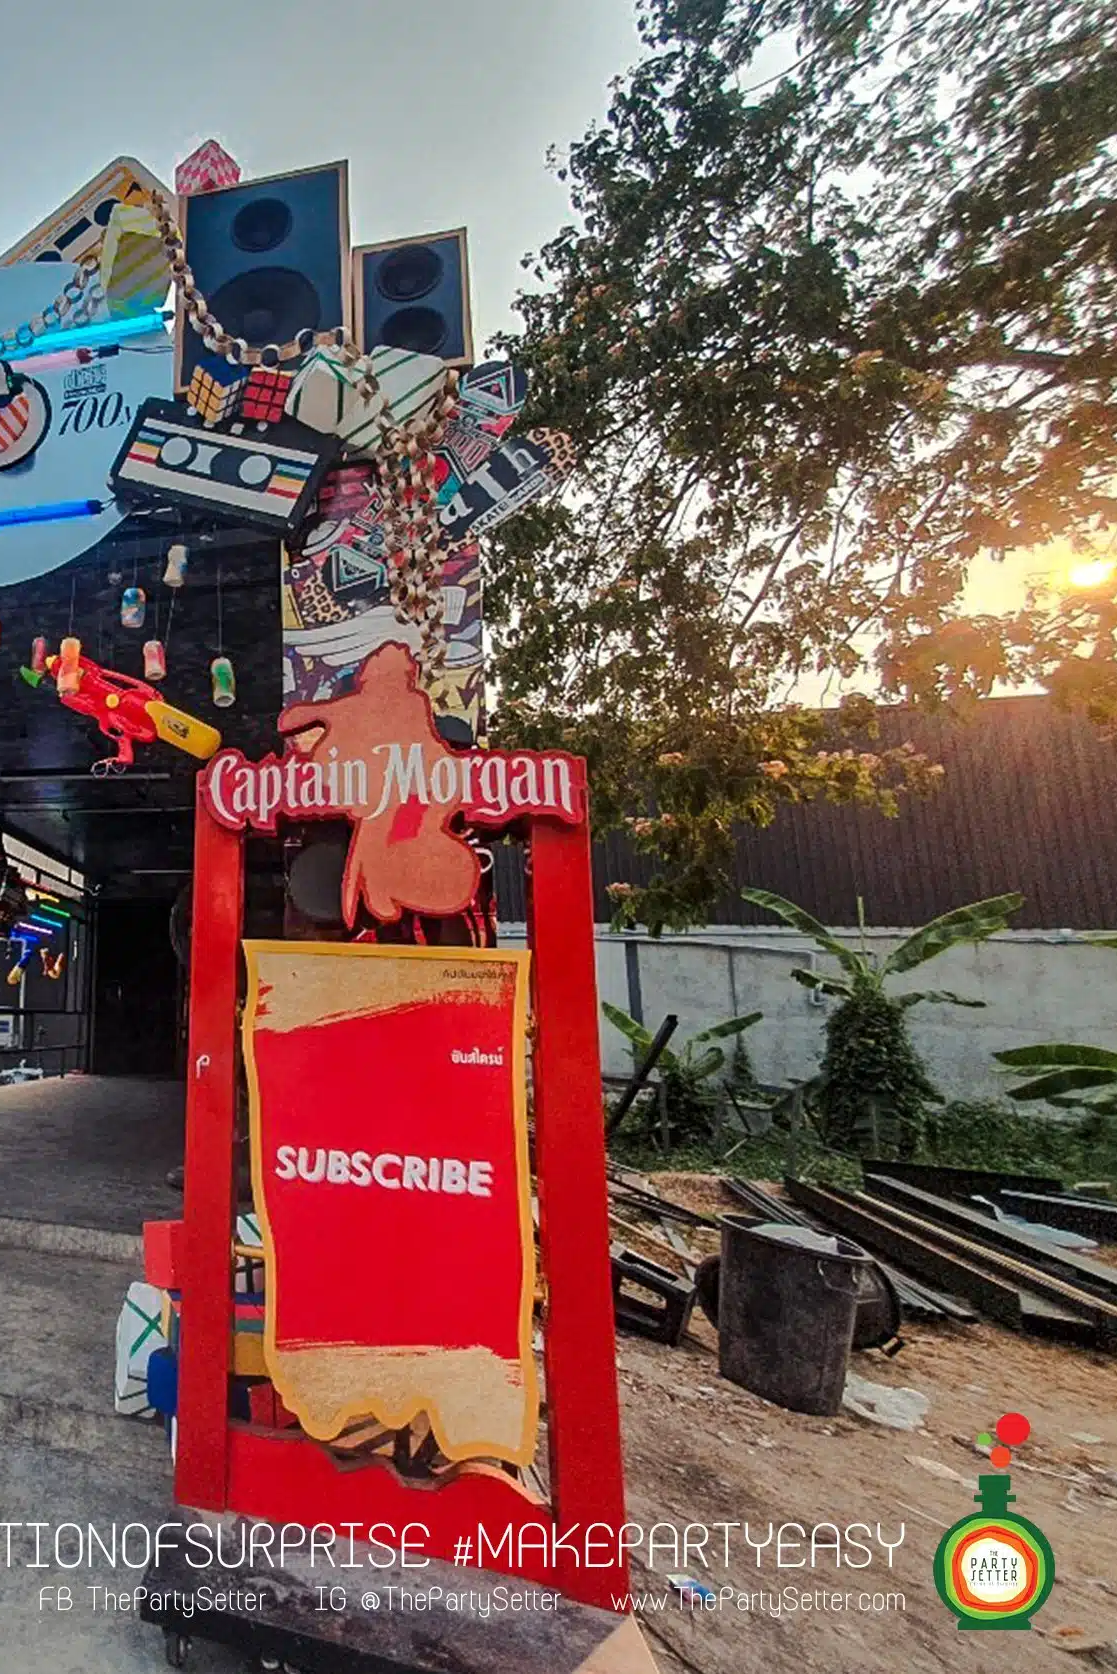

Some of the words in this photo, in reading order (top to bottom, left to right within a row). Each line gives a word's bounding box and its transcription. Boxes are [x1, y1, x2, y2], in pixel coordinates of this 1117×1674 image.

[209, 745, 368, 823] Captain
[369, 742, 574, 822] Morgan
[274, 1144, 494, 1198] SUBSCRIBE
